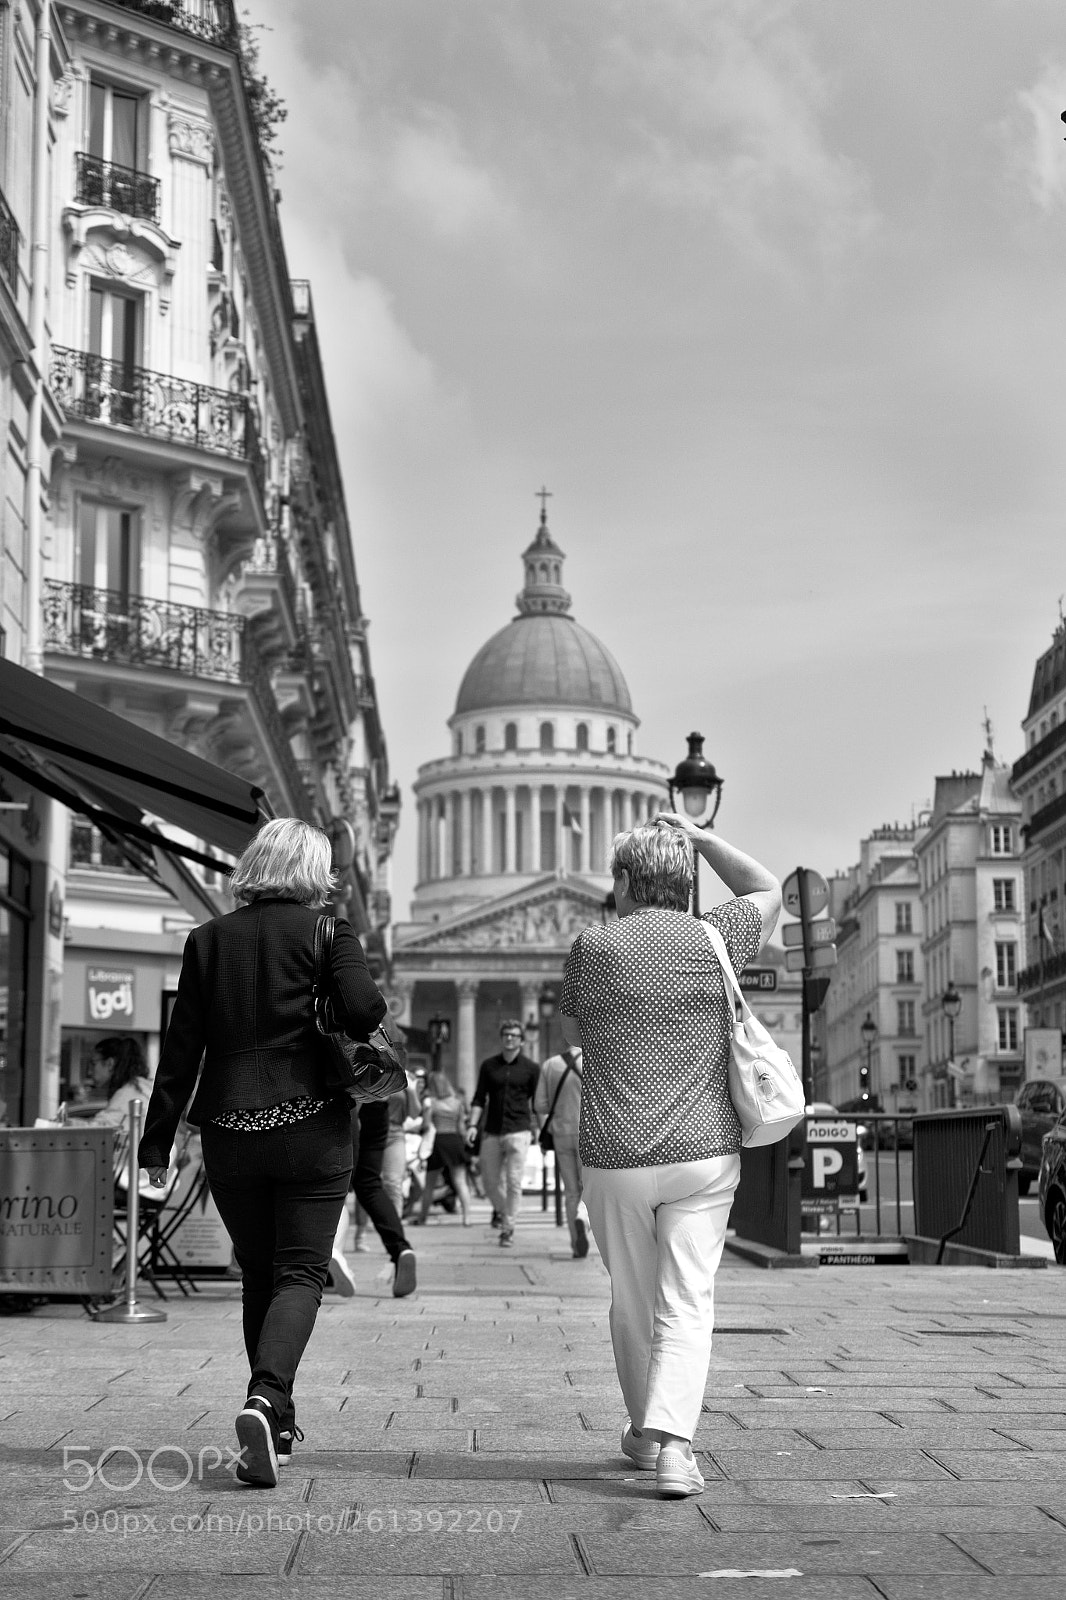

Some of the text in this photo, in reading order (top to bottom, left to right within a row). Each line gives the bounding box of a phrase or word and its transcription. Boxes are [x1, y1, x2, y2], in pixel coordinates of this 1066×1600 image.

[809, 1128, 849, 1138] NDIGO
[812, 1148, 844, 1188] P
[0, 1186, 78, 1219] rino
